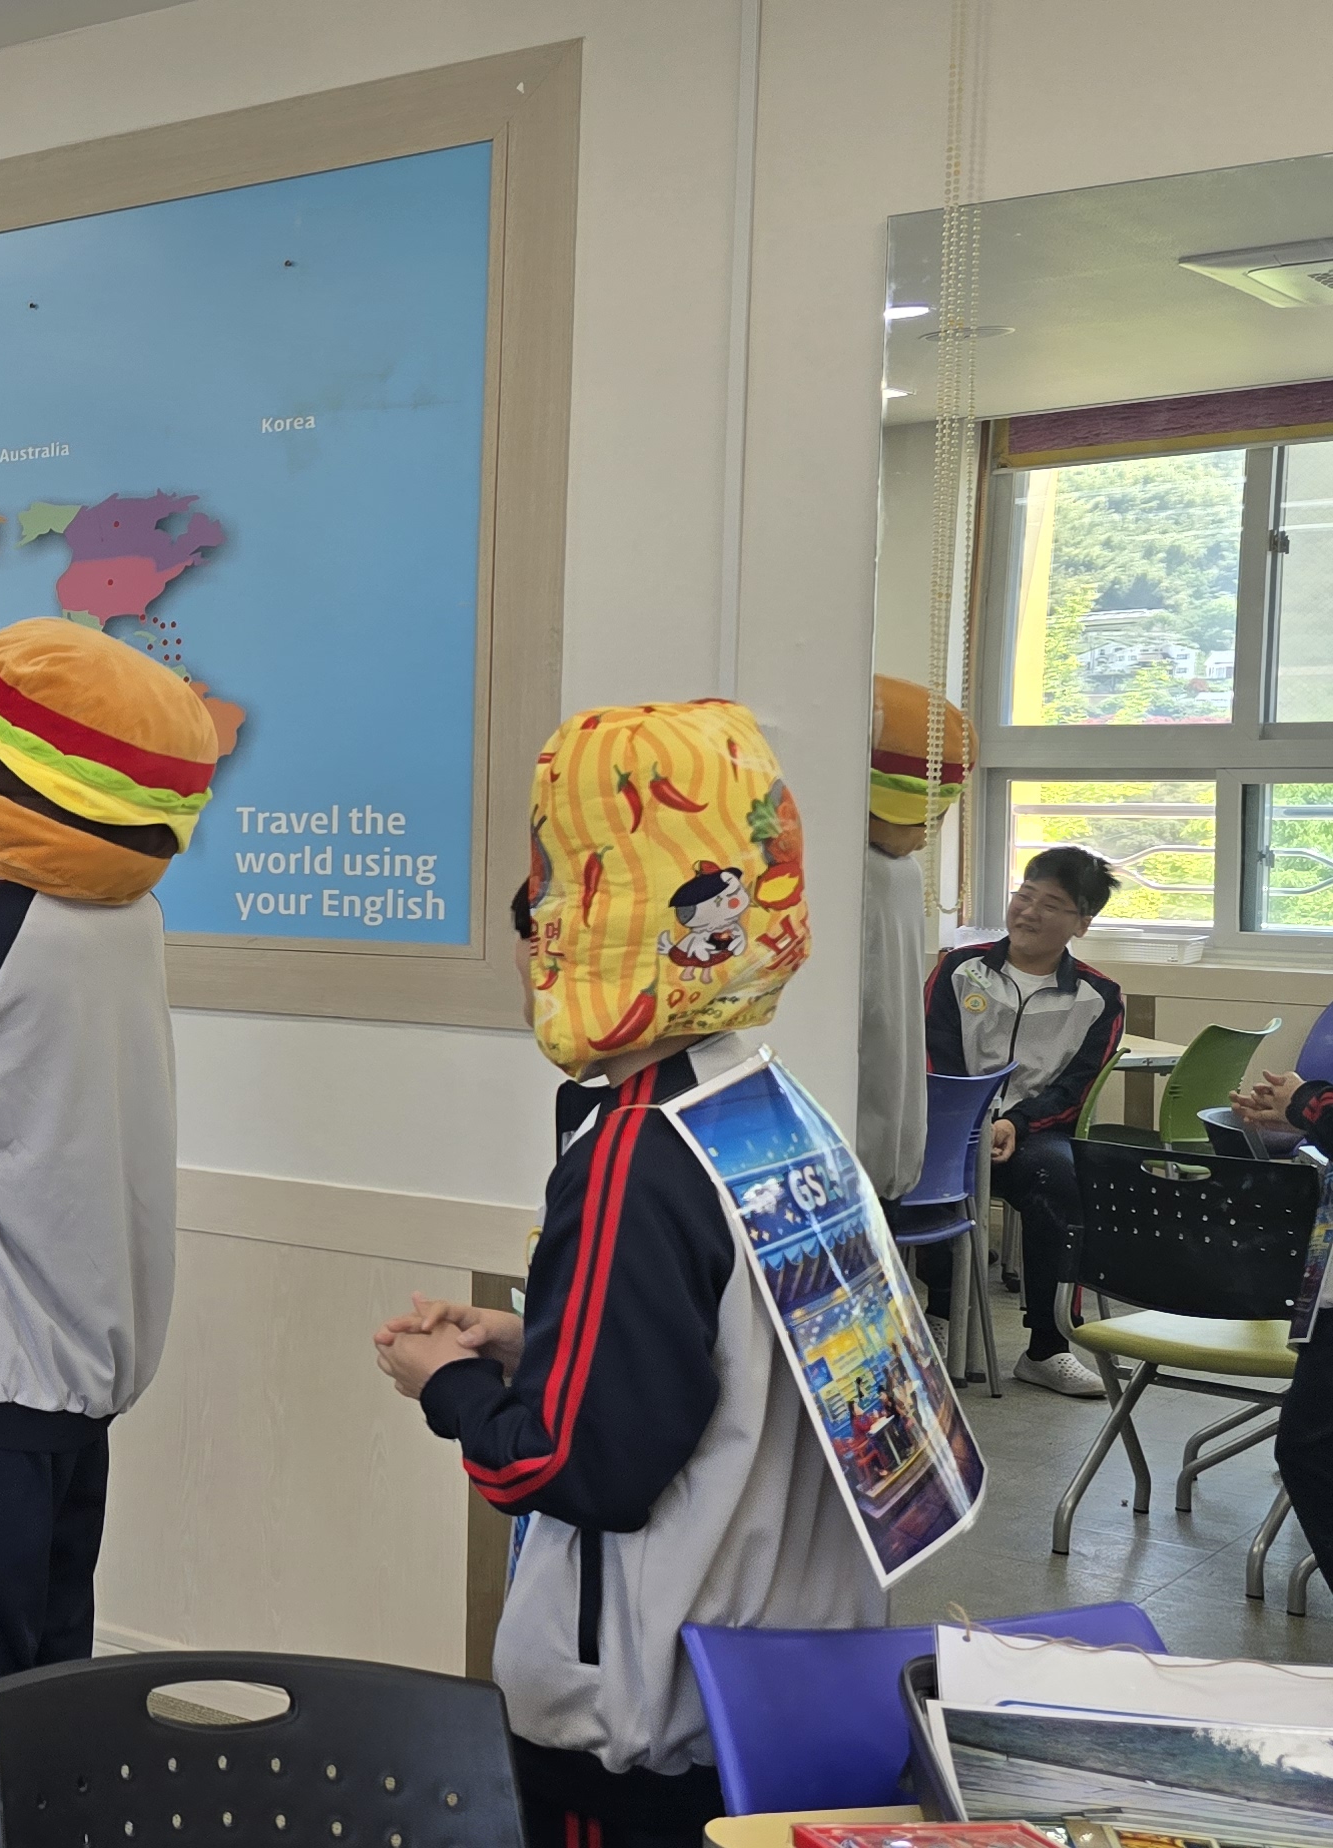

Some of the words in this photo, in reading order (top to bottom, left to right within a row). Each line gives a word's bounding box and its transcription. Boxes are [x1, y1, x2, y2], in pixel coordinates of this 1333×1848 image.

[261, 415, 316, 433] Korea
[236, 804, 339, 835] Travel
[348, 804, 406, 835] the
[235, 846, 332, 875] world
[343, 847, 437, 886] using
[235, 892, 313, 921] your
[322, 889, 445, 926] English
